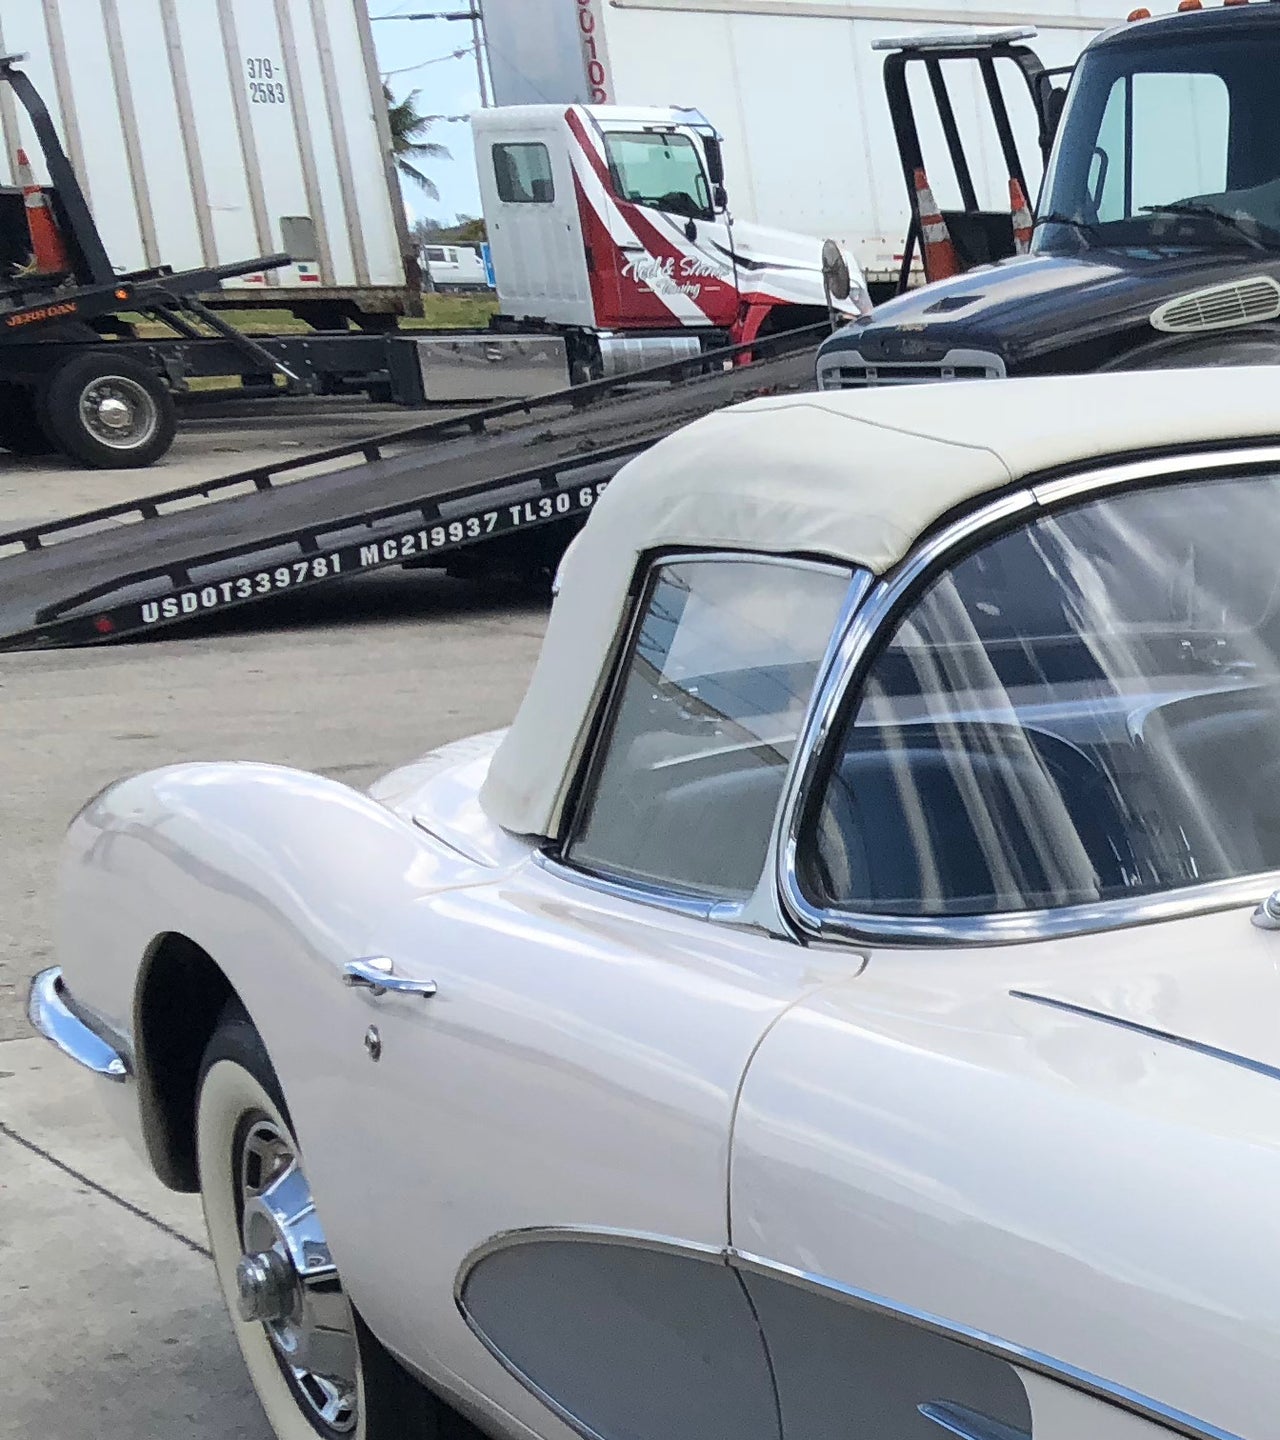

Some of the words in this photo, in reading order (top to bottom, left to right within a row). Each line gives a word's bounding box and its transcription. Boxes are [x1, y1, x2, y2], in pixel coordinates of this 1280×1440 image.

[249, 82, 285, 104] 2583
[141, 553, 341, 623] USDOT339781
[360, 511, 498, 567] MC219937
[509, 493, 571, 525] TL30
